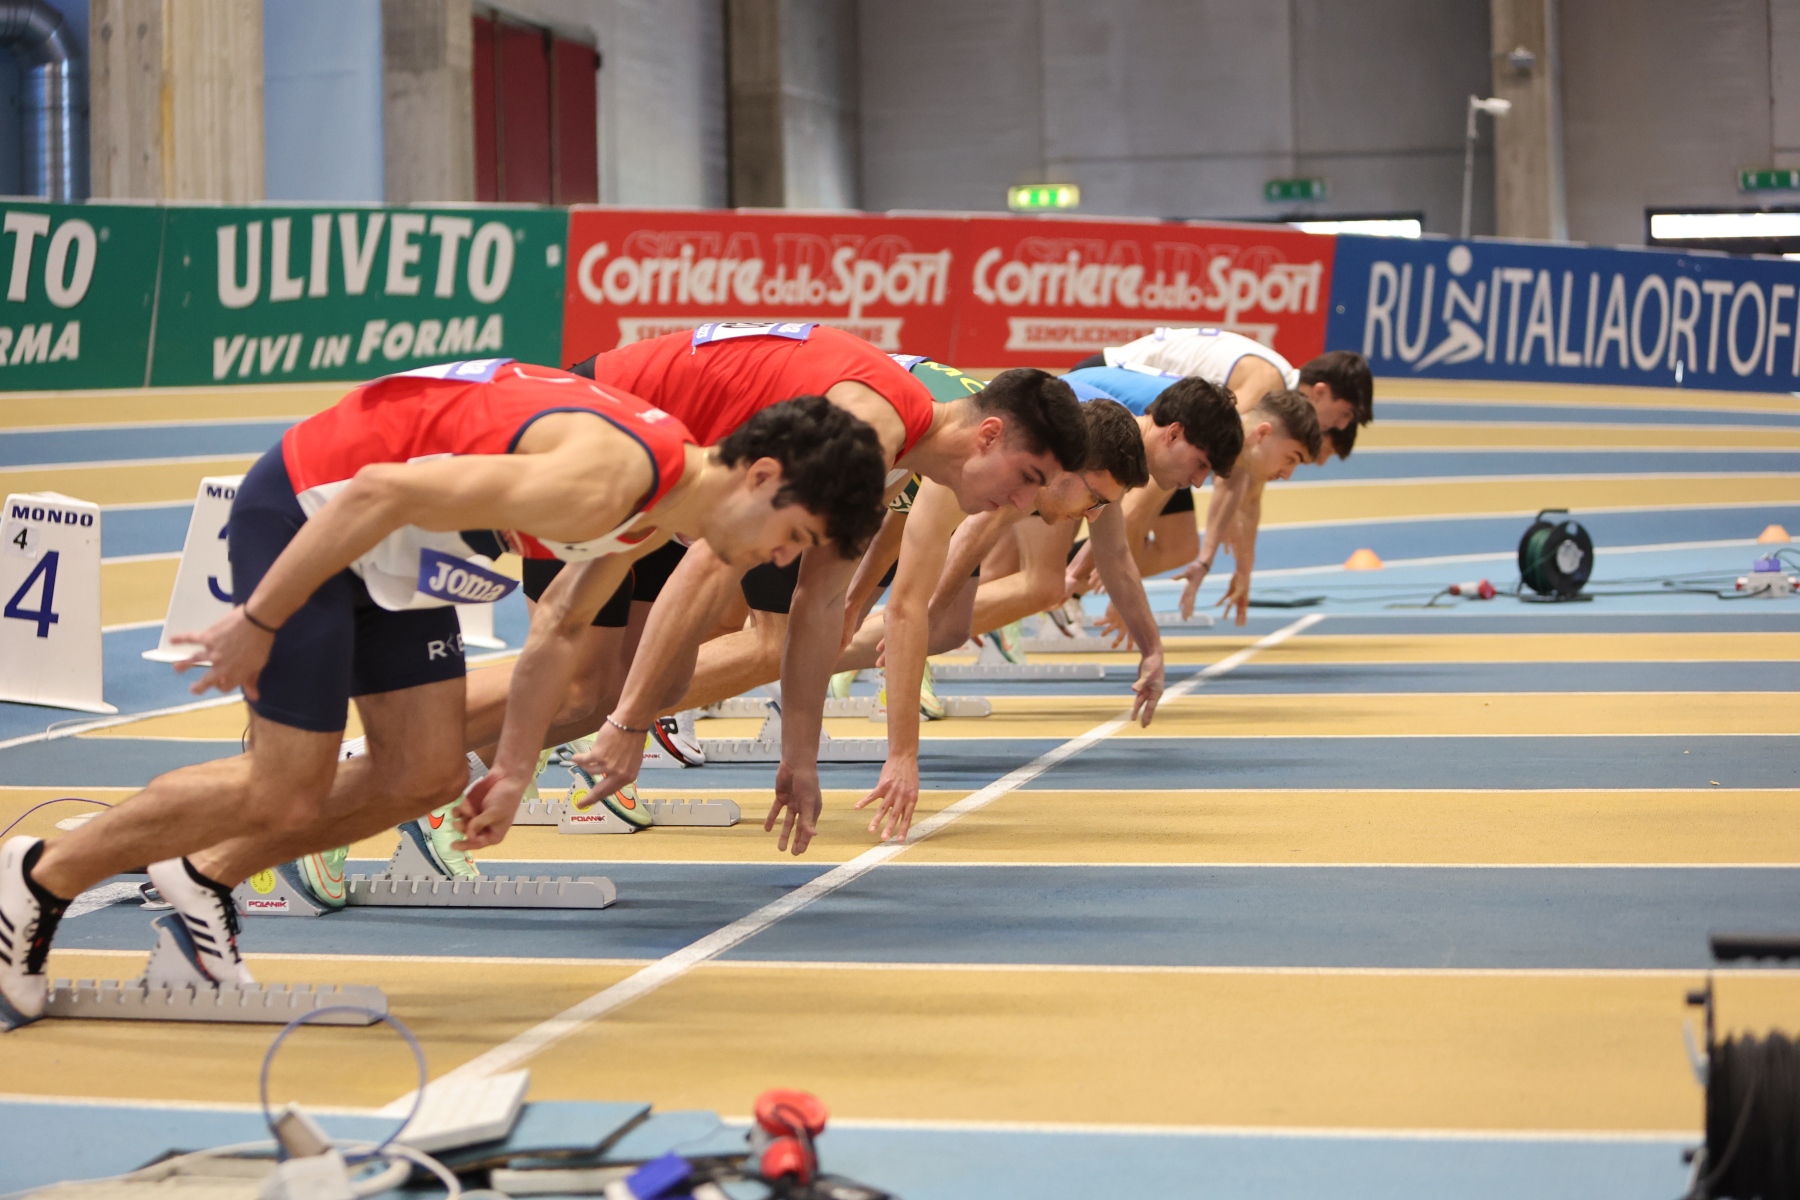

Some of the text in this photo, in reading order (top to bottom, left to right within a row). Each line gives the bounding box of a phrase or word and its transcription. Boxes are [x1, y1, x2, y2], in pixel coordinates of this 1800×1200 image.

[217, 212, 515, 307] ULIVETO
[578, 242, 763, 305] Corriere
[828, 247, 951, 322] Sport
[973, 247, 1143, 307] Corriere
[1204, 256, 1323, 325] Sport
[213, 314, 503, 380] VIVI IN FORMA
[11, 505, 93, 527] MONDO
[13, 527, 28, 550] 4
[4, 550, 59, 638] 4
